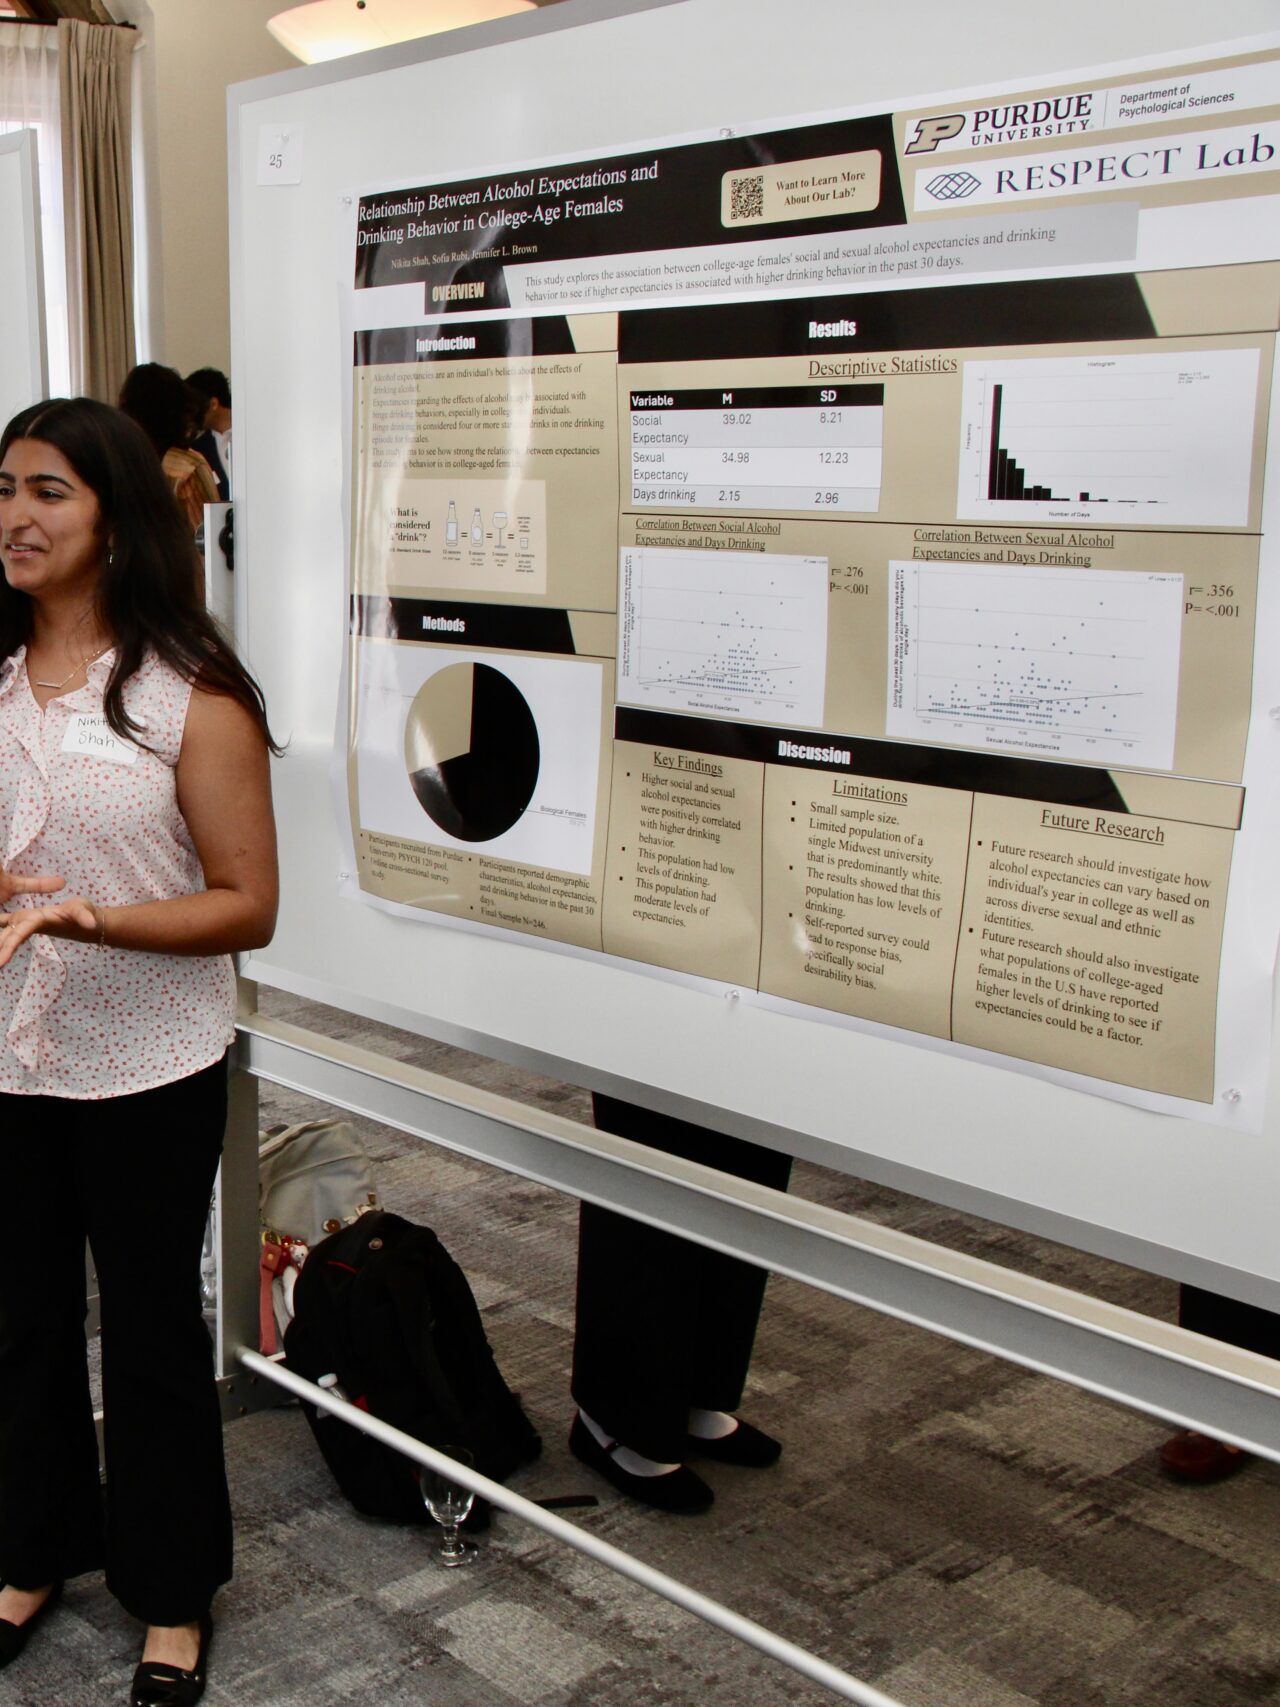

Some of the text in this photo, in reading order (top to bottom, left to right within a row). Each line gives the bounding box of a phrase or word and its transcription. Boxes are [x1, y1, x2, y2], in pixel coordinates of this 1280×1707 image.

[1120, 84, 1191, 105] Department of
[972, 94, 1093, 132] PURDUE
[1118, 92, 1235, 118] Psychological Sciences
[971, 120, 1091, 146] UNIVERSITY
[269, 154, 283, 169] 25
[995, 133, 1275, 195] RESPECT Lab
[358, 160, 658, 222] Relationship Between Alcohol Expectations and
[776, 171, 866, 191] Want to Learn More
[784, 187, 856, 206] About Our Lab?
[358, 197, 624, 246] Drinking Behavior in College-Age Females
[391, 245, 538, 269] Nikita Shah, Sofia Rubi, Jennifer L. Brown
[525, 275, 542, 287] This
[544, 273, 565, 286] study
[566, 271, 600, 285] explores
[601, 268, 614, 280] the
[616, 264, 661, 279] association
[663, 262, 700, 274] between
[703, 258, 754, 272] college-age
[794, 249, 820, 263] social
[823, 247, 840, 260] and
[841, 244, 871, 258] sexual
[874, 240, 910, 256] alcohol
[912, 235, 980, 254] expectancies
[982, 231, 1004, 246] and
[1006, 228, 1056, 244] drinking
[432, 282, 485, 302] OVERVIEW
[808, 319, 857, 338] Results
[416, 336, 476, 353] Introduction
[808, 355, 958, 379] Descriptive Statistics
[632, 390, 837, 407] Variable M SD
[632, 412, 843, 426] Social 39.02 8.21
[632, 432, 689, 445] Expectancy
[633, 451, 849, 464] Sexual 34.98 12.23
[633, 469, 688, 482] Expectancy
[633, 488, 839, 504] Days drinking 2.15 2.96
[635, 518, 781, 534] Correlation Between Social Alcohol
[635, 534, 766, 553] Expectancies and Days Drinking
[913, 529, 1115, 547] Correlation Between Sexual Alcohol
[912, 546, 1092, 569] Expectancies and Days Drinking
[831, 567, 864, 578] r= .276
[829, 582, 869, 595] P= <.001
[1189, 584, 1234, 598] r= .356
[1184, 603, 1240, 618] P= <.001
[422, 615, 466, 633] Methods
[78, 730, 115, 748] Shah
[778, 740, 851, 765] Discussion
[653, 751, 723, 776] Key Findings
[641, 772, 736, 798] Higher social and sexual
[832, 780, 908, 804] Limitations
[810, 802, 900, 825] Small sample size.
[808, 817, 924, 846] Limited population of a
[1040, 809, 1165, 843] Future Research
[991, 840, 1212, 889] Future research should investigate how
